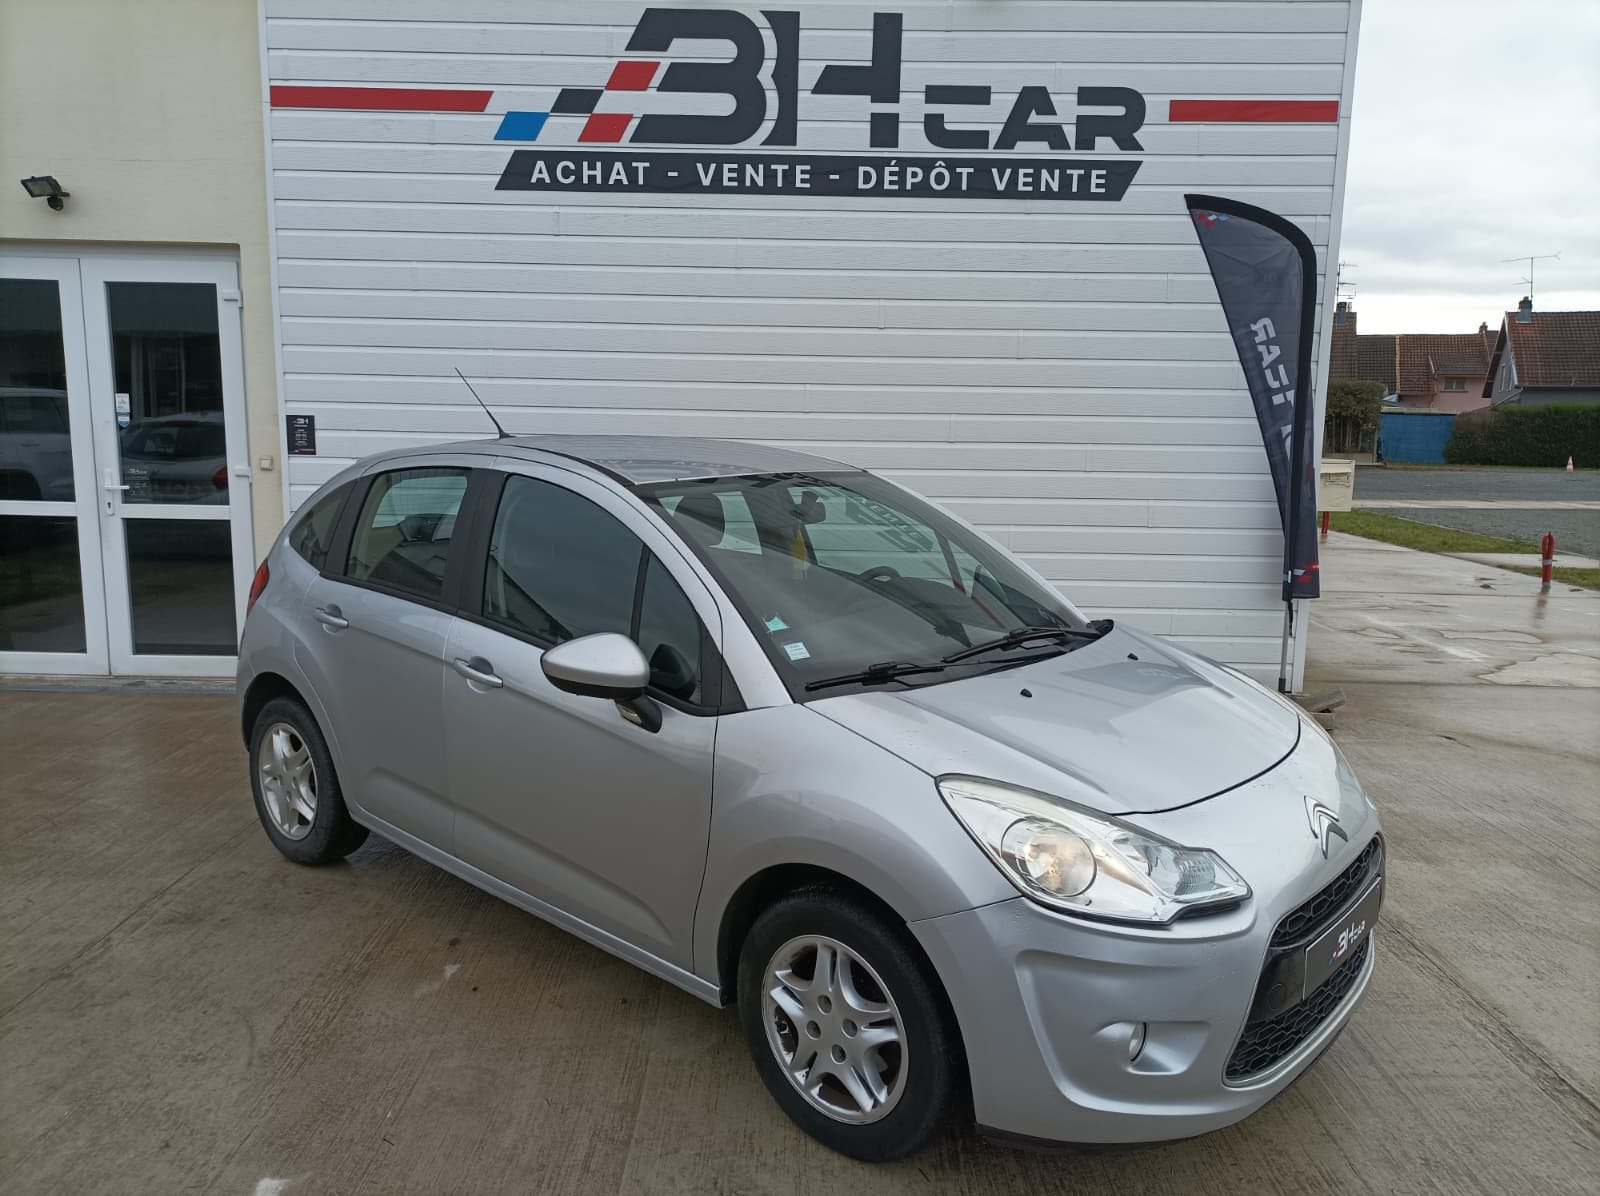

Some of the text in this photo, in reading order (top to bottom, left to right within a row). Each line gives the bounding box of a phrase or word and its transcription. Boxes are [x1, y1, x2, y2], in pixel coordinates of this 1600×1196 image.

[530, 160, 650, 186] ACHAT
[697, 164, 812, 189] VENTE
[858, 160, 975, 192] DÉPÔT
[991, 168, 1107, 193] VENTE
